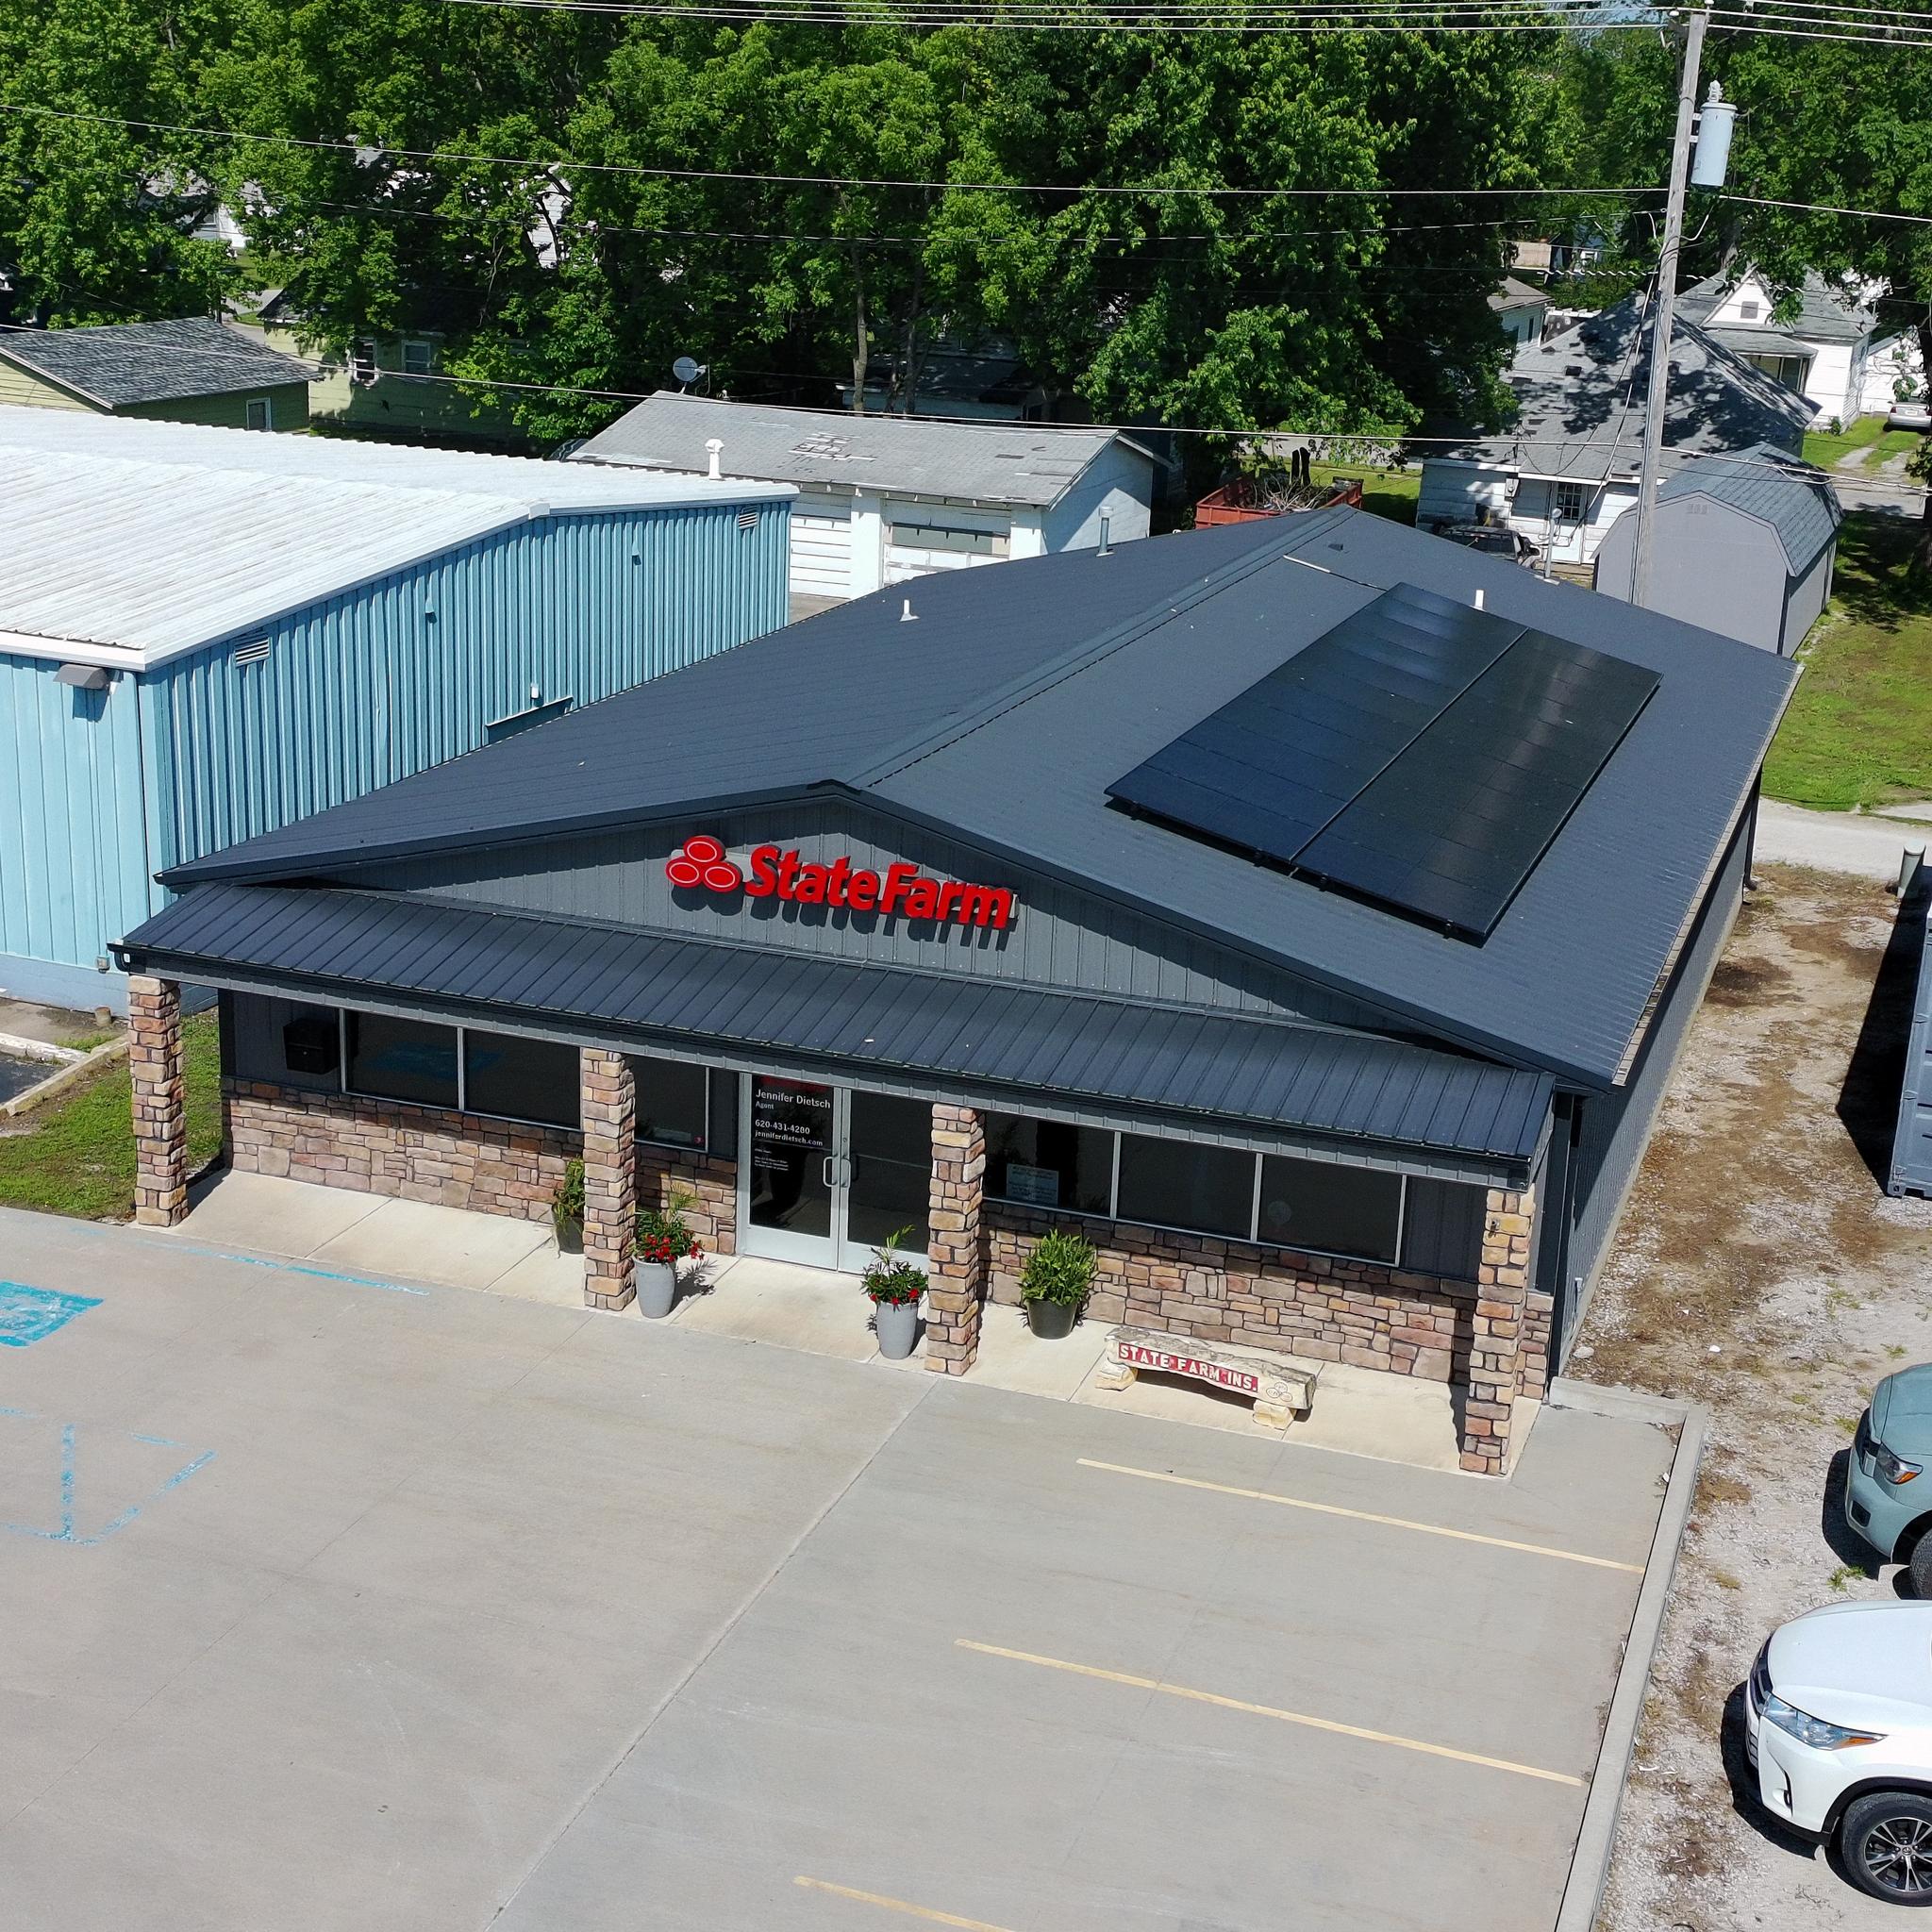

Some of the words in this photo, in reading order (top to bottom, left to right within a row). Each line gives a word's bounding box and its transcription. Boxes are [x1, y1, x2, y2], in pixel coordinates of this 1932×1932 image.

[756, 1089, 794, 1103] Jennifer
[796, 1095, 831, 1109] Dietsch
[756, 1101, 774, 1109] Agent
[755, 1130, 824, 1146] jenniferdietsch.com
[1120, 1344, 1170, 1368] STATE
[1177, 1358, 1221, 1382] FARM
[1227, 1371, 1257, 1391] INS.
